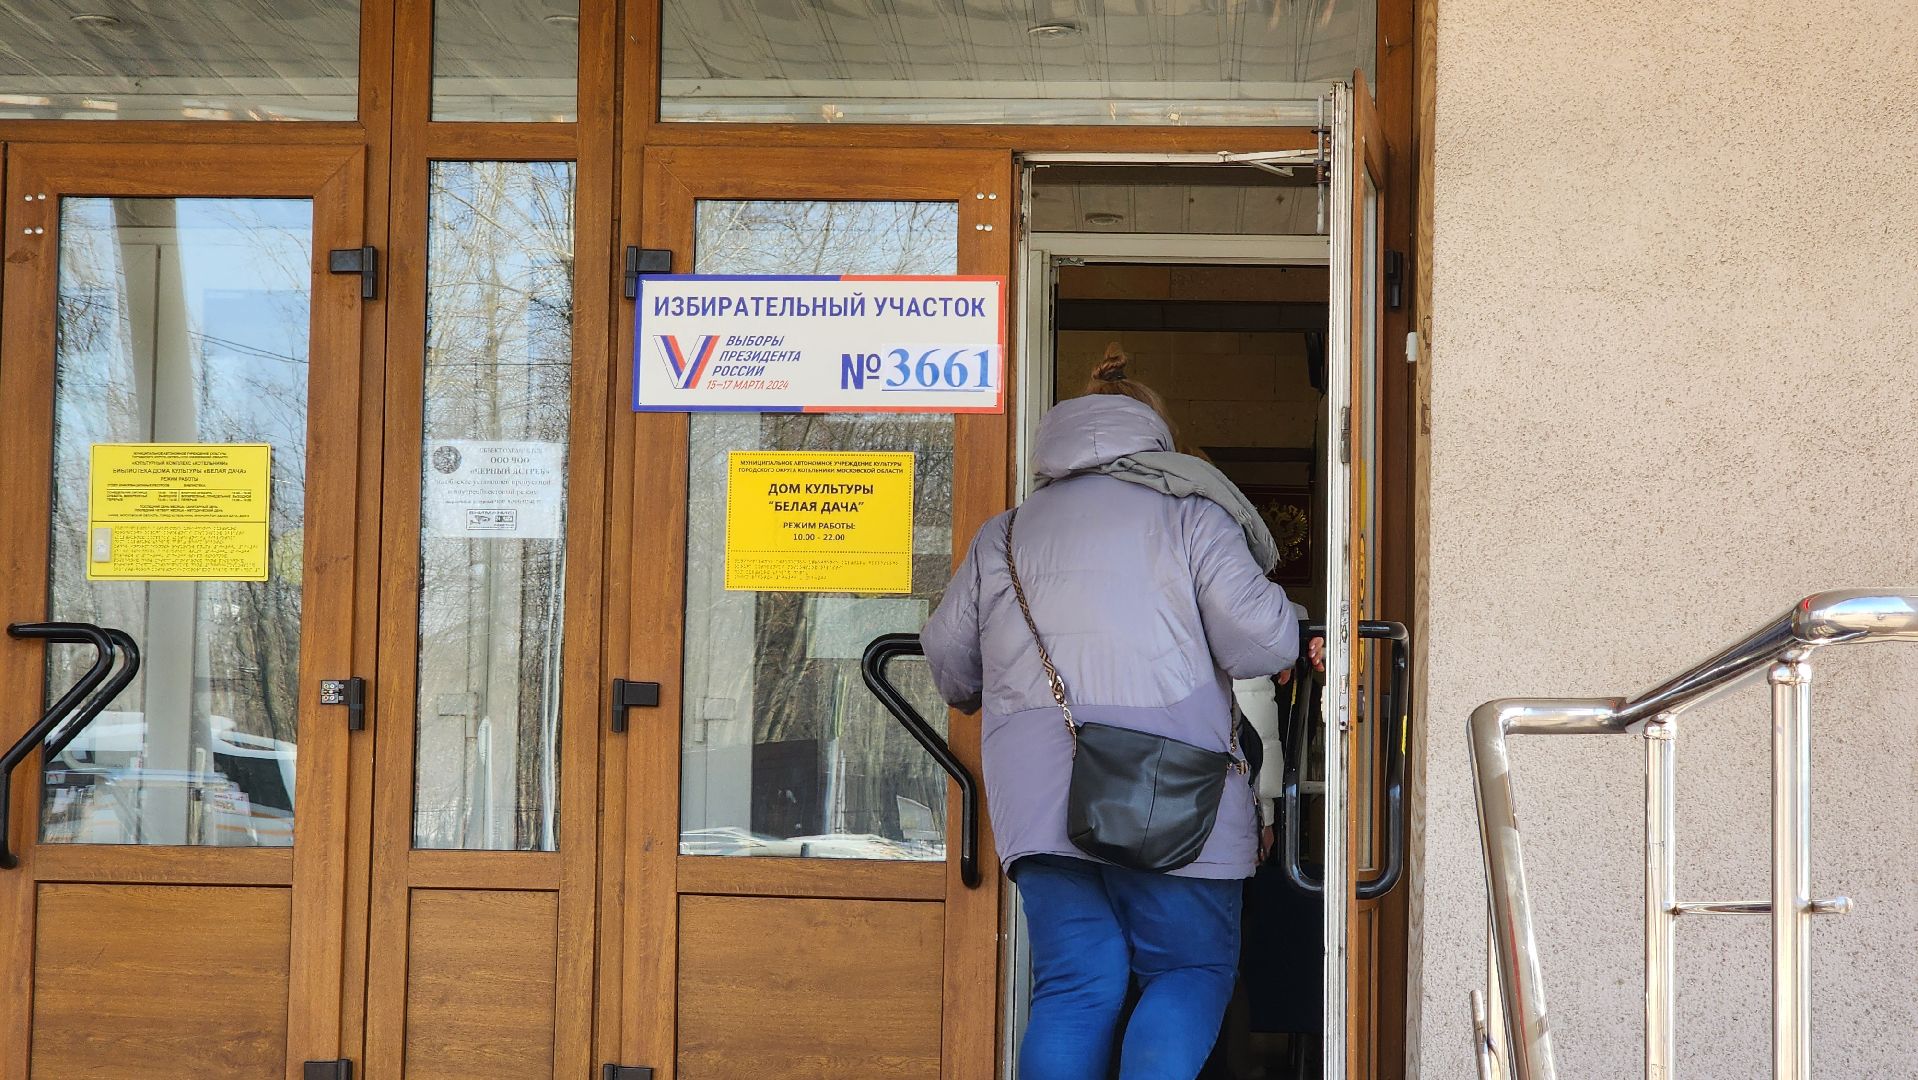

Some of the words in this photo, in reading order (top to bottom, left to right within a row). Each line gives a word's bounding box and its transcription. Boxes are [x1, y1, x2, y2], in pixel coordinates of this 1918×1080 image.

[654, 291, 866, 317] ИЗБИРАТЕЛЬНЫЙ
[873, 296, 986, 317] УЧАСТОК
[725, 335, 785, 347] ВЫБОРЫ
[718, 350, 802, 364] ПРЕЗИДЕНТА
[711, 365, 766, 377] РОССИИ
[733, 380, 765, 390] МАРТА
[765, 380, 790, 390] 2024
[767, 483, 801, 496] ДОМ
[805, 483, 874, 495] КУЛЬТУРЫ
[818, 522, 856, 530] РАБОТЫ:
[793, 533, 815, 541] 10.00
[823, 533, 846, 541] 22.00
